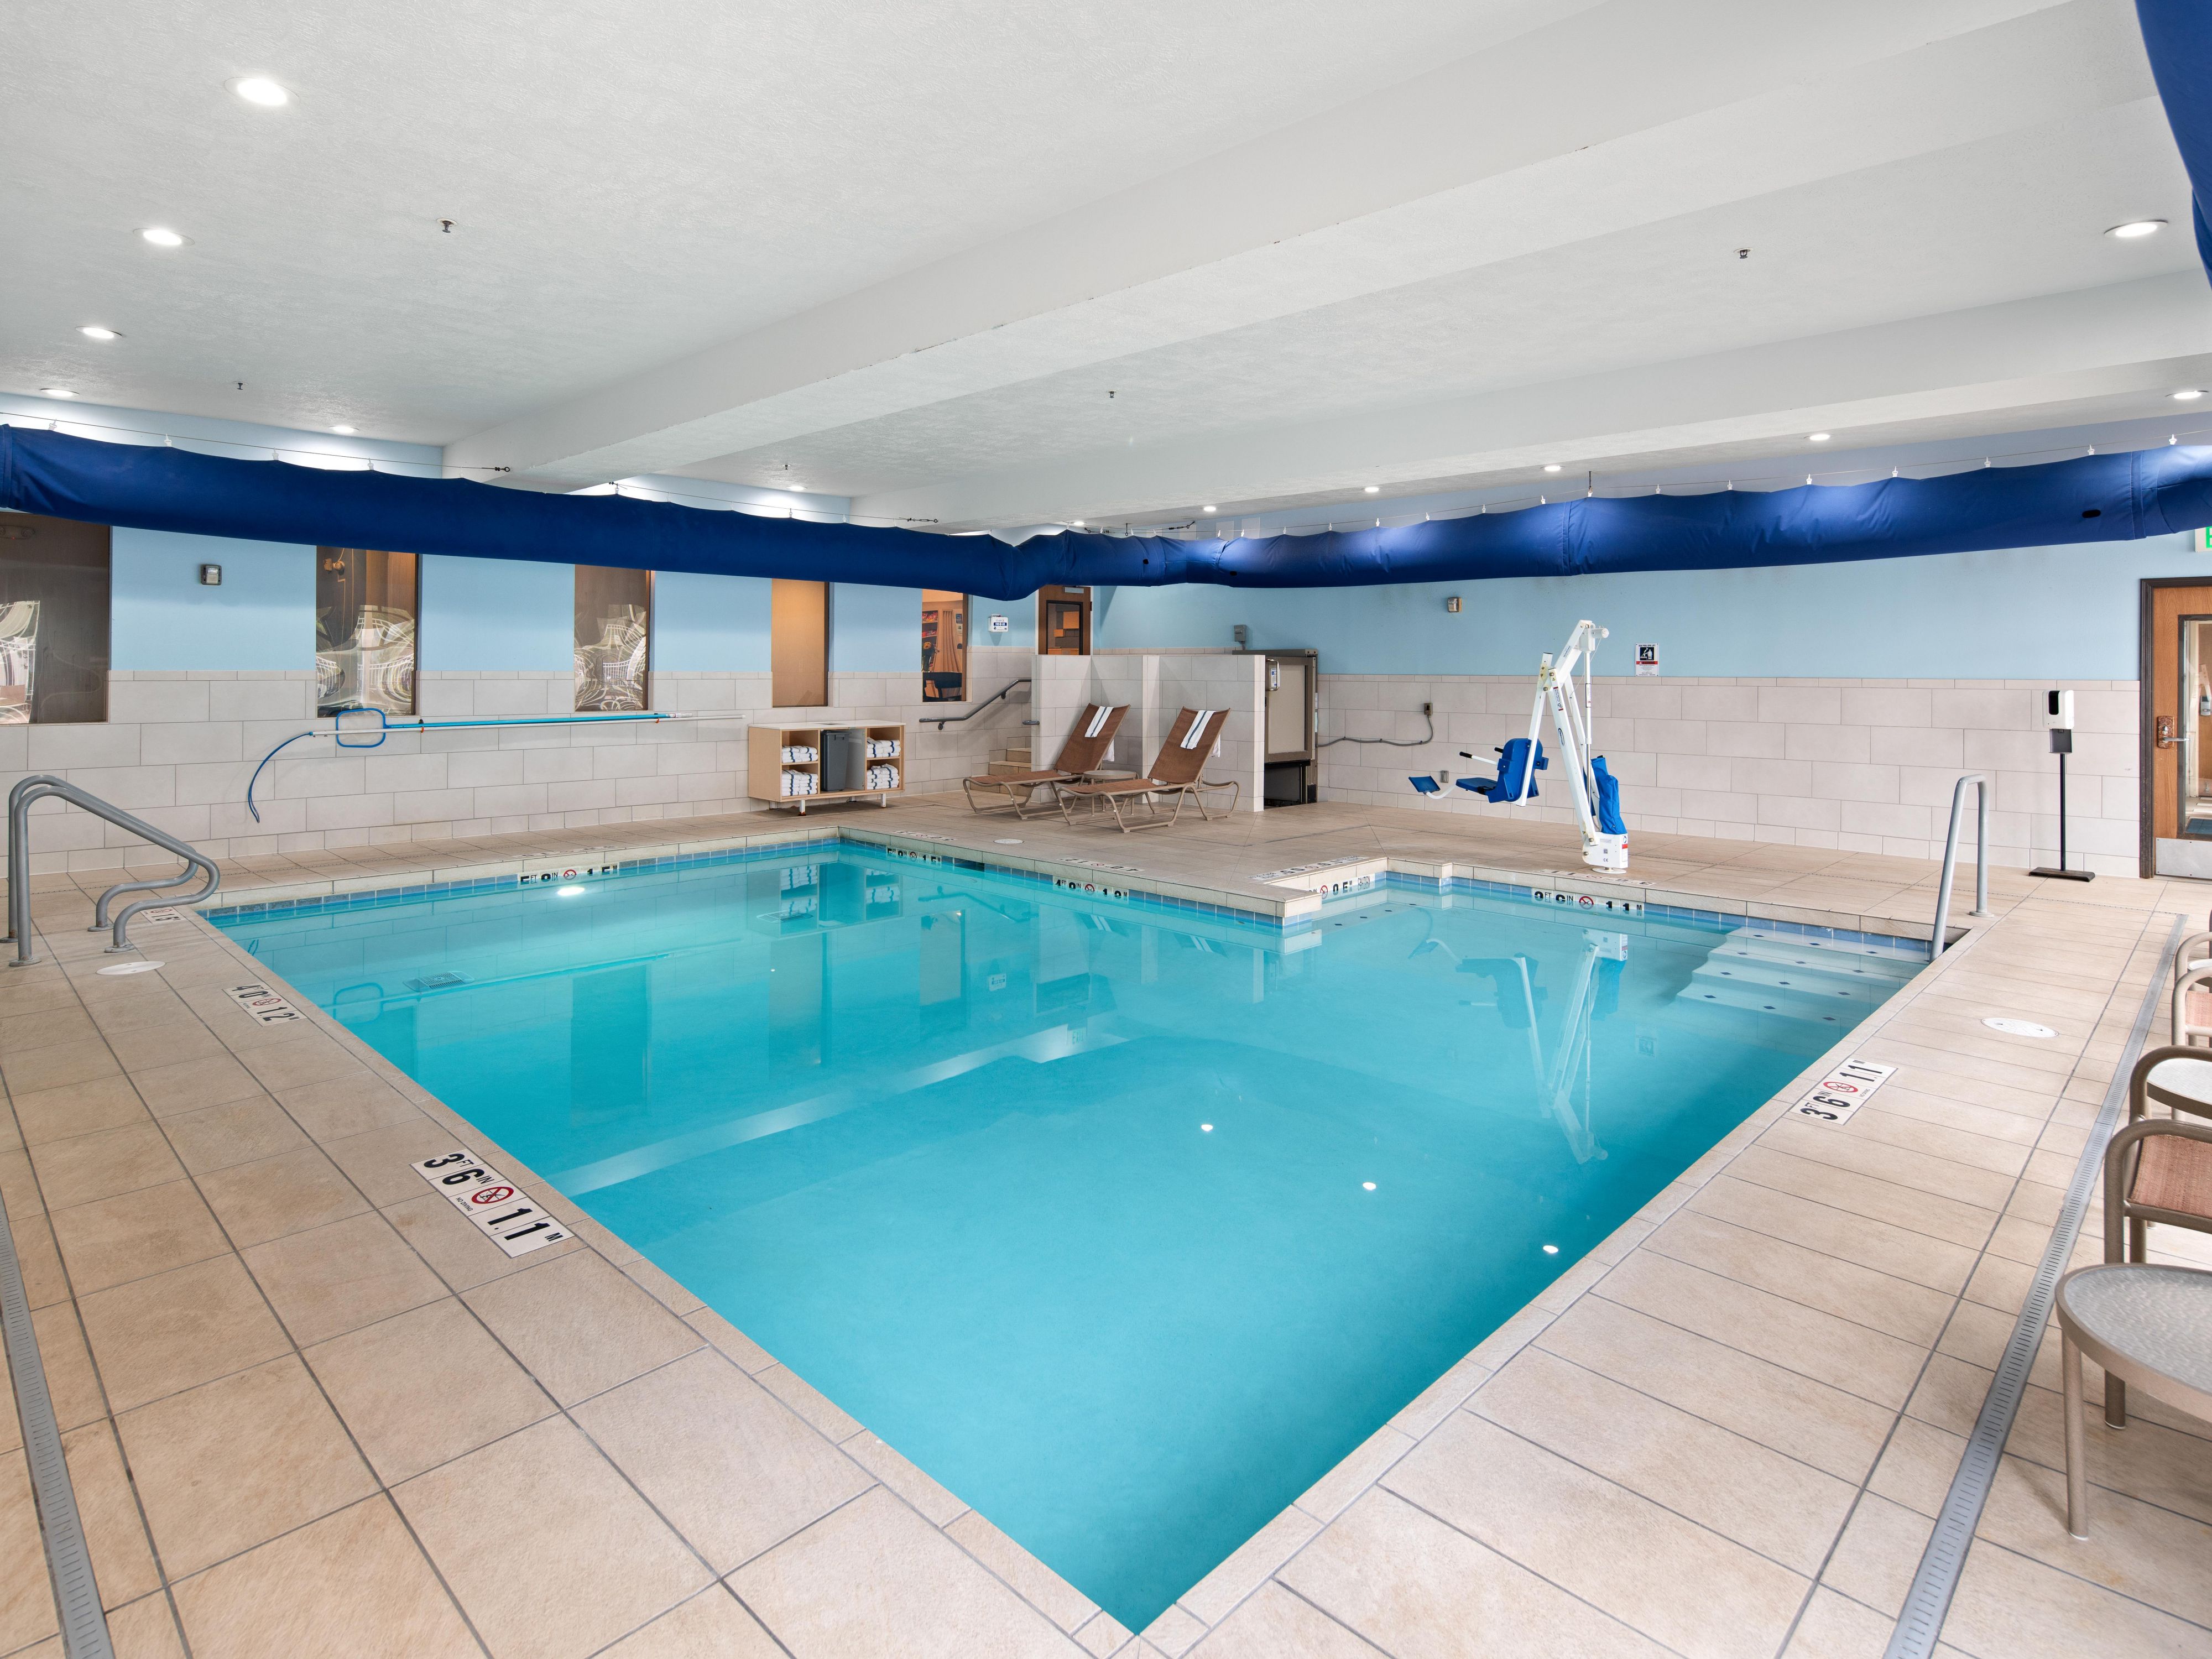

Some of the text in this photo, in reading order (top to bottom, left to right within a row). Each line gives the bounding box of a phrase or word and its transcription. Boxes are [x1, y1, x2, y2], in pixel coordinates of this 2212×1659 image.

[423, 1153, 495, 1185] 3 FT 6 IN
[460, 1202, 473, 1212] DIVING
[544, 1232, 564, 1241] M
